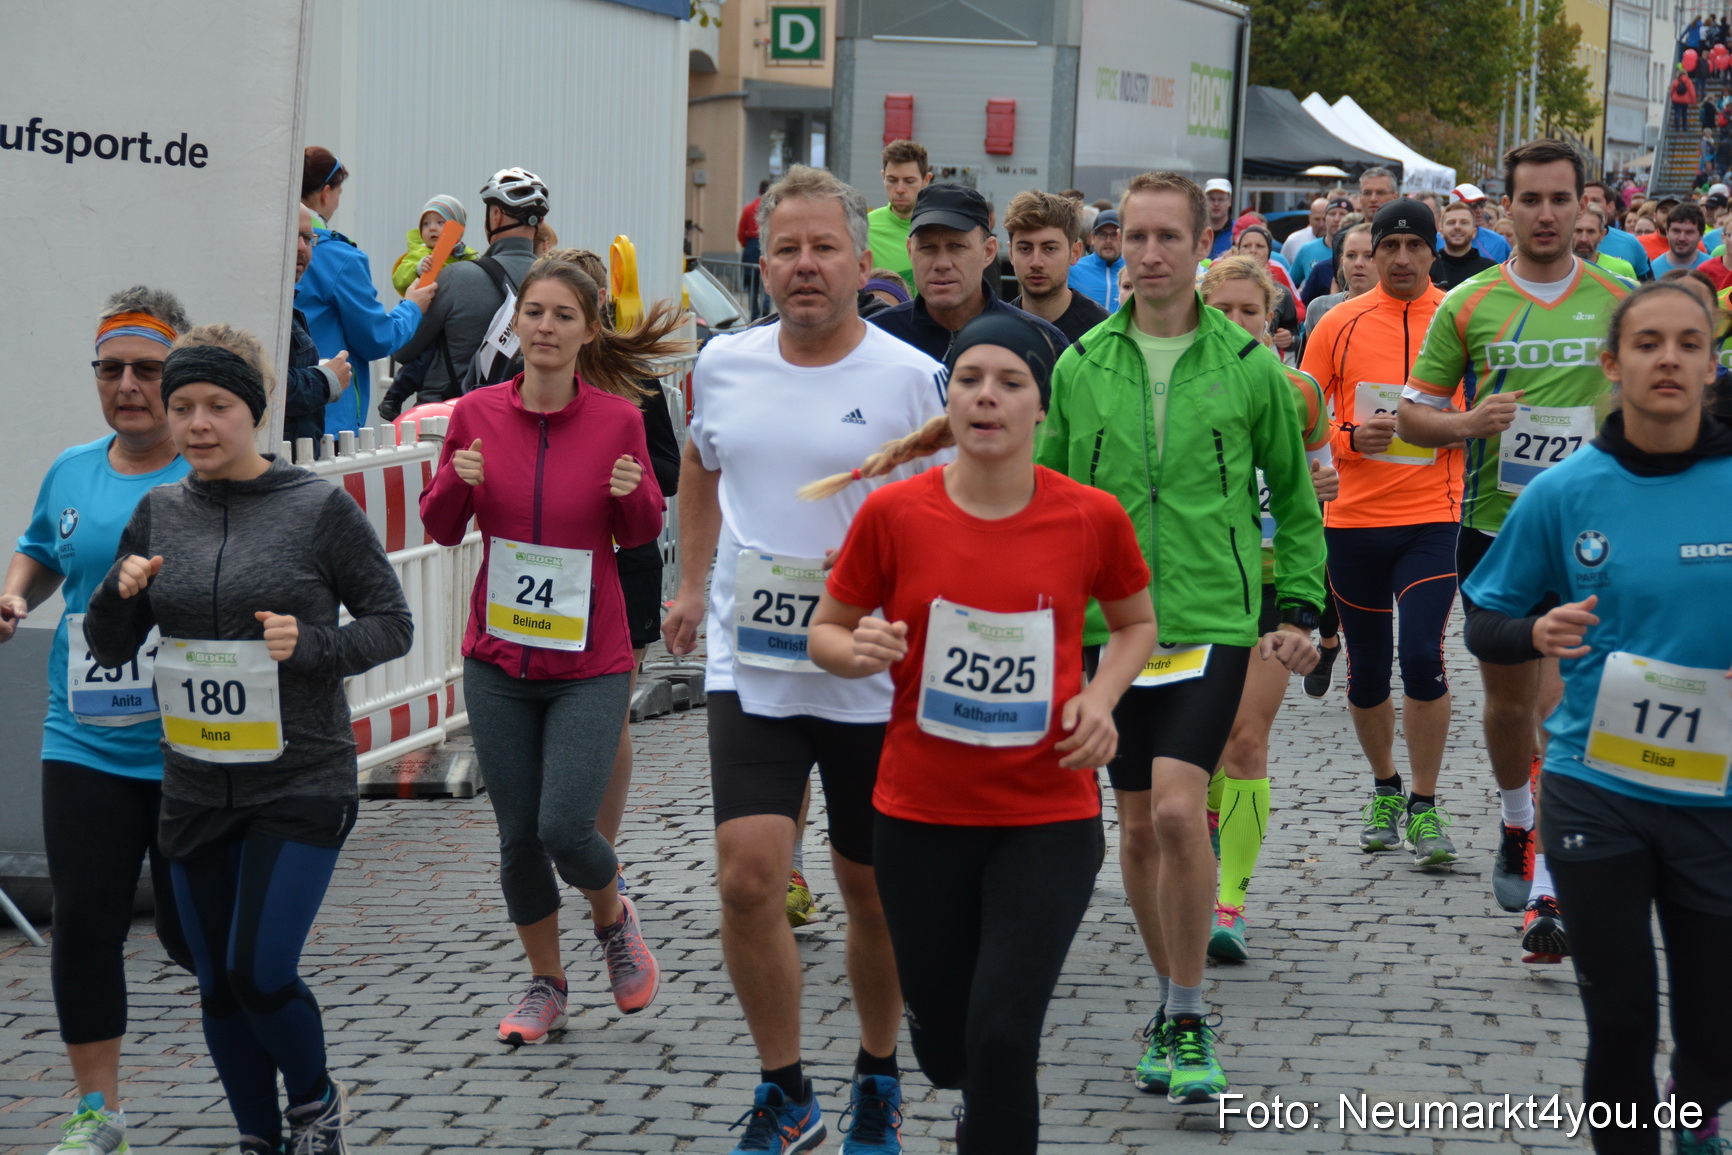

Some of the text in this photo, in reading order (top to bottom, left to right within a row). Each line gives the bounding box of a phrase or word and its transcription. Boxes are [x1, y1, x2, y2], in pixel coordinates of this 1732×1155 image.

[779, 14, 815, 53] D
[1188, 69, 1231, 132] BOCK
[0, 117, 209, 168] ufsport.de
[1540, 415, 1571, 425] BOCK
[1514, 432, 1583, 462] 2727
[526, 553, 563, 567] BOCK
[516, 575, 553, 608] 24
[513, 614, 551, 630] Belinda
[980, 624, 1024, 638] BOCK
[195, 652, 237, 663] BOCK
[1144, 658, 1171, 670] ndré
[943, 647, 1036, 694] 2525
[1659, 674, 1707, 691] BOCK
[111, 694, 142, 707] Anita
[181, 678, 246, 716] 180
[953, 702, 1018, 723] Katharina
[1633, 699, 1702, 743] 171
[201, 728, 231, 741] Anna
[1641, 749, 1676, 767] Elisa
